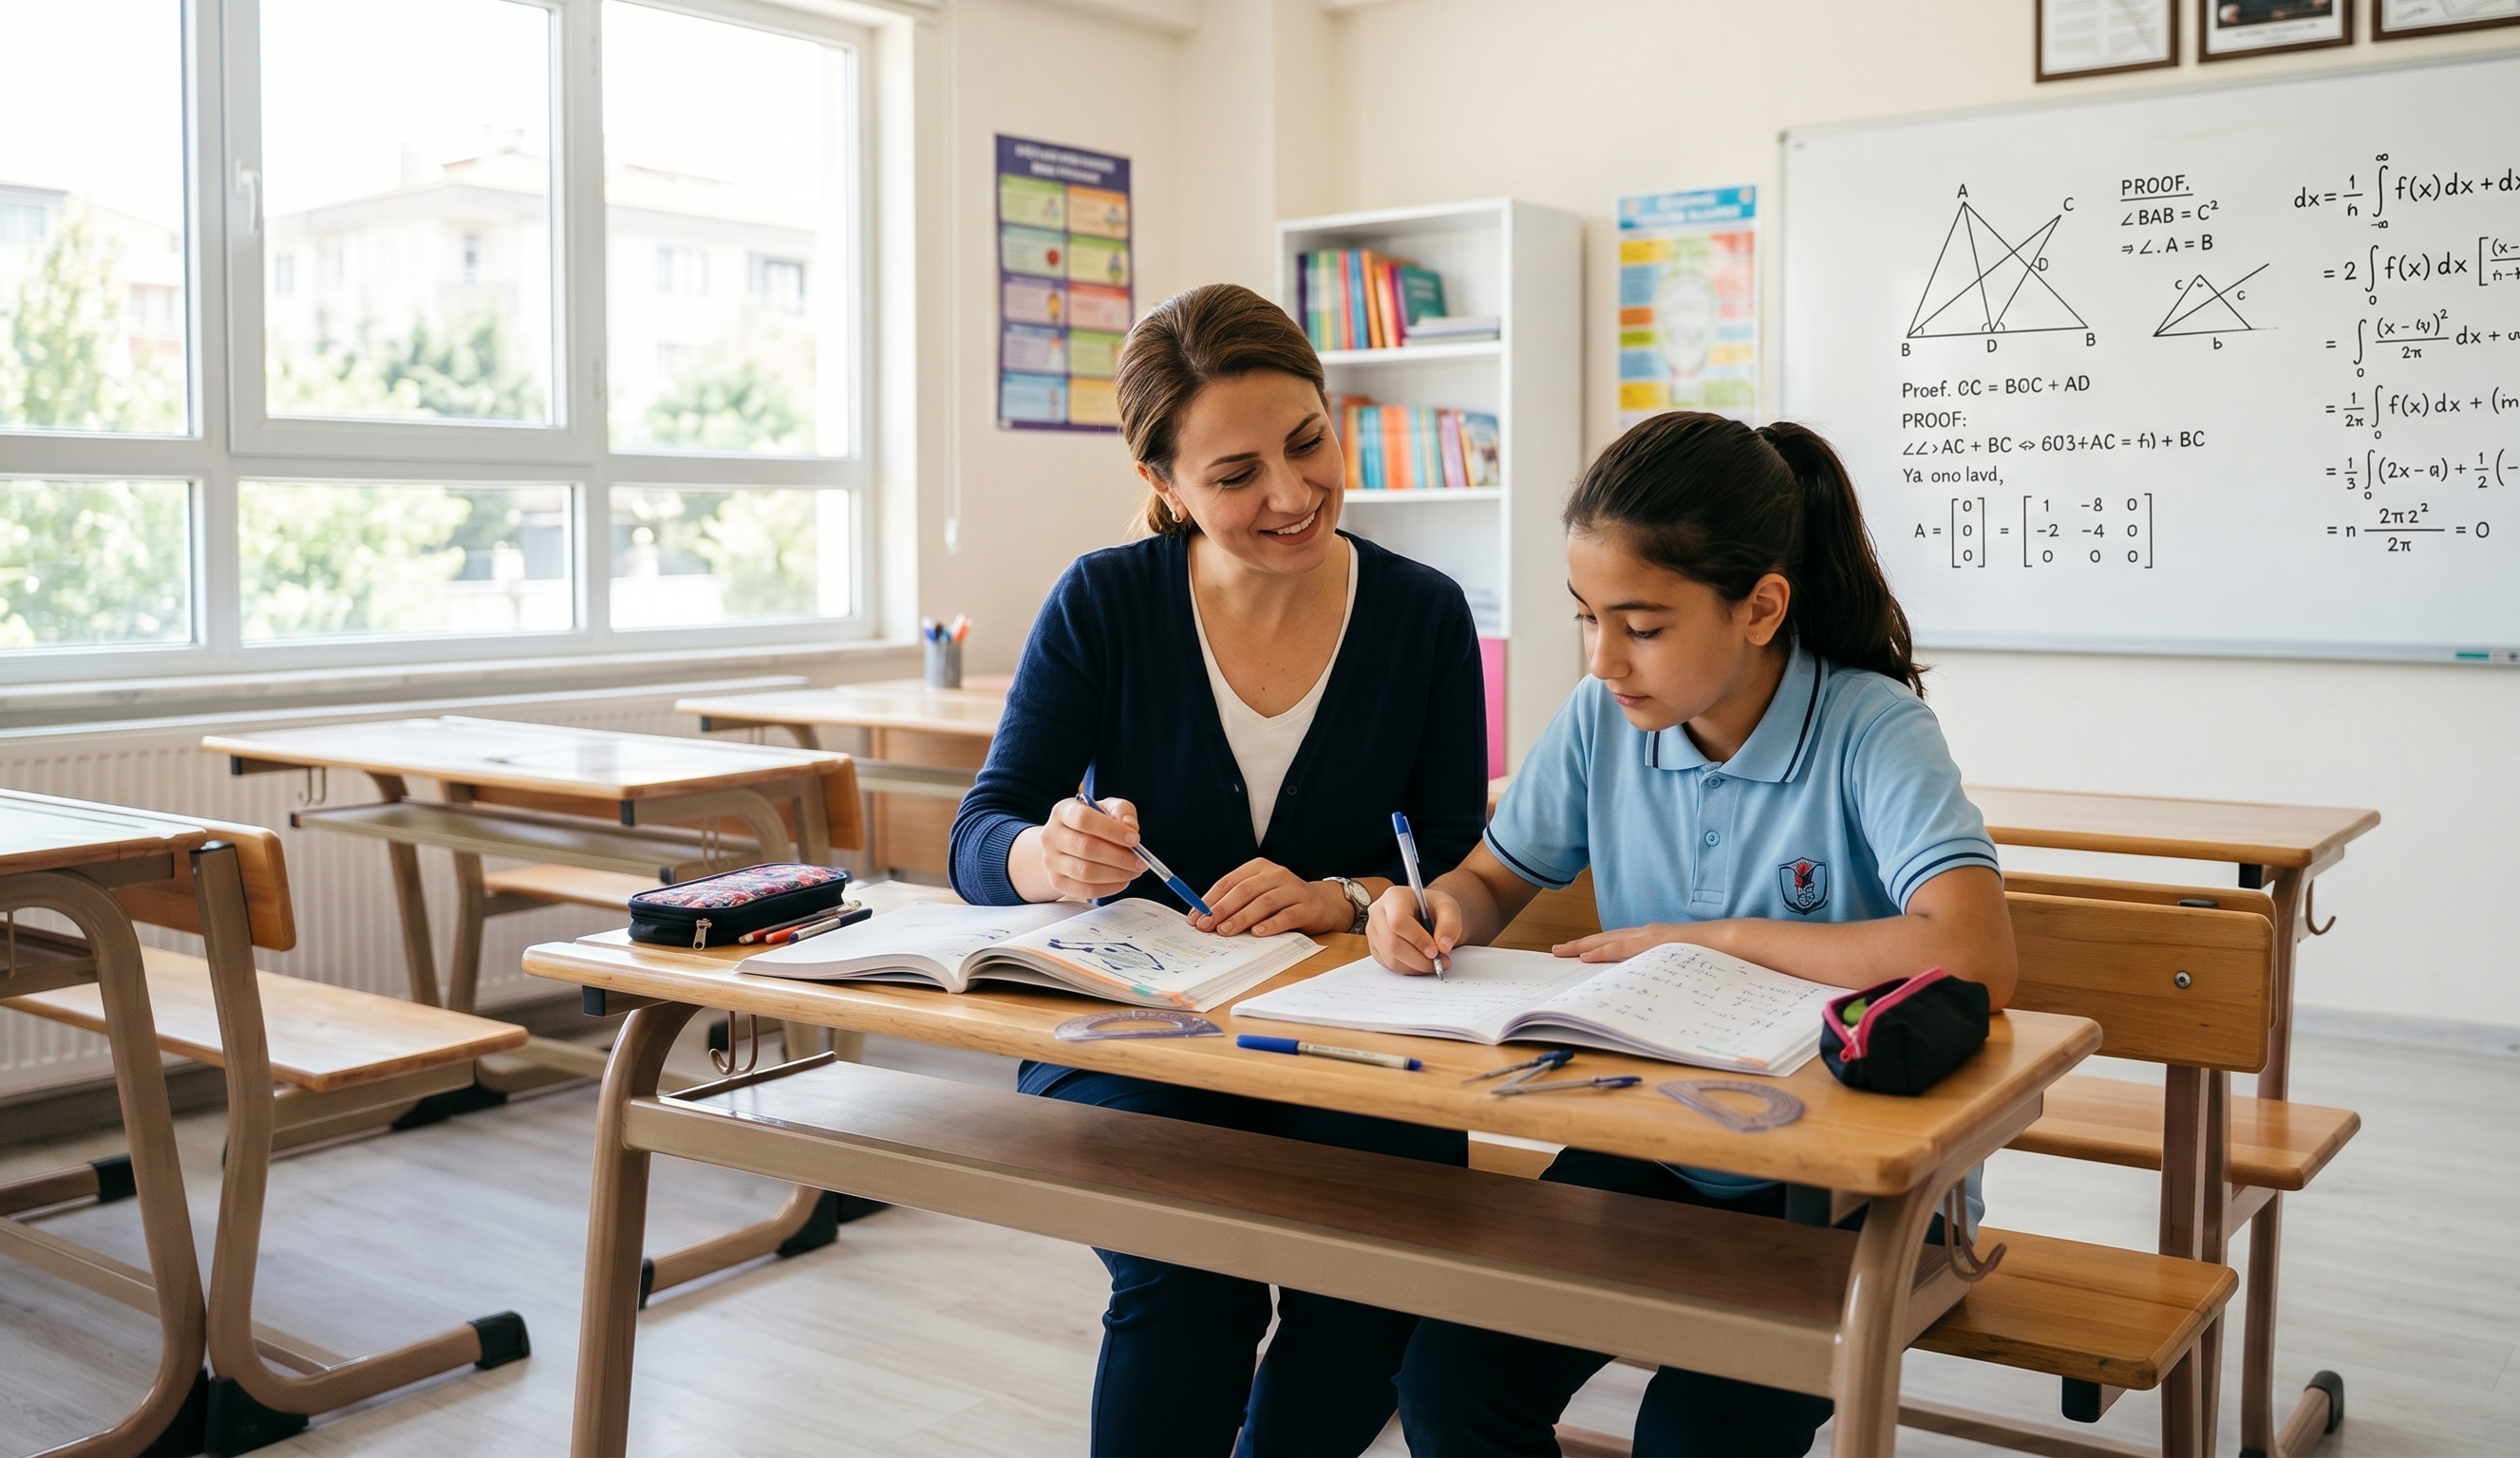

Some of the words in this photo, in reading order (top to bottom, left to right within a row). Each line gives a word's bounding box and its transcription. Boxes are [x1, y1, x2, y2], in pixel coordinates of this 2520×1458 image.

[1956, 182, 1969, 199] A
[2293, 186, 2321, 209] dx
[2062, 196, 2075, 212] C
[2201, 234, 2213, 252] B
[2039, 257, 2049, 271] D
[2343, 261, 2358, 281] 2
[2212, 336, 2224, 350] b
[2455, 325, 2482, 346] dx
[1901, 342, 1911, 358] B
[1986, 338, 1998, 353] D
[2085, 331, 2097, 347] B
[2063, 374, 2091, 392] AD
[1902, 410, 1966, 430] PROOF:
[1988, 436, 2013, 454] BC
[2179, 430, 2206, 448] BC
[1930, 471, 1962, 483] ono
[2346, 477, 2357, 491] 3
[2477, 475, 2489, 489] 2
[2043, 498, 2049, 513] 1
[1913, 522, 1927, 539] A
[2345, 525, 2357, 538] n
